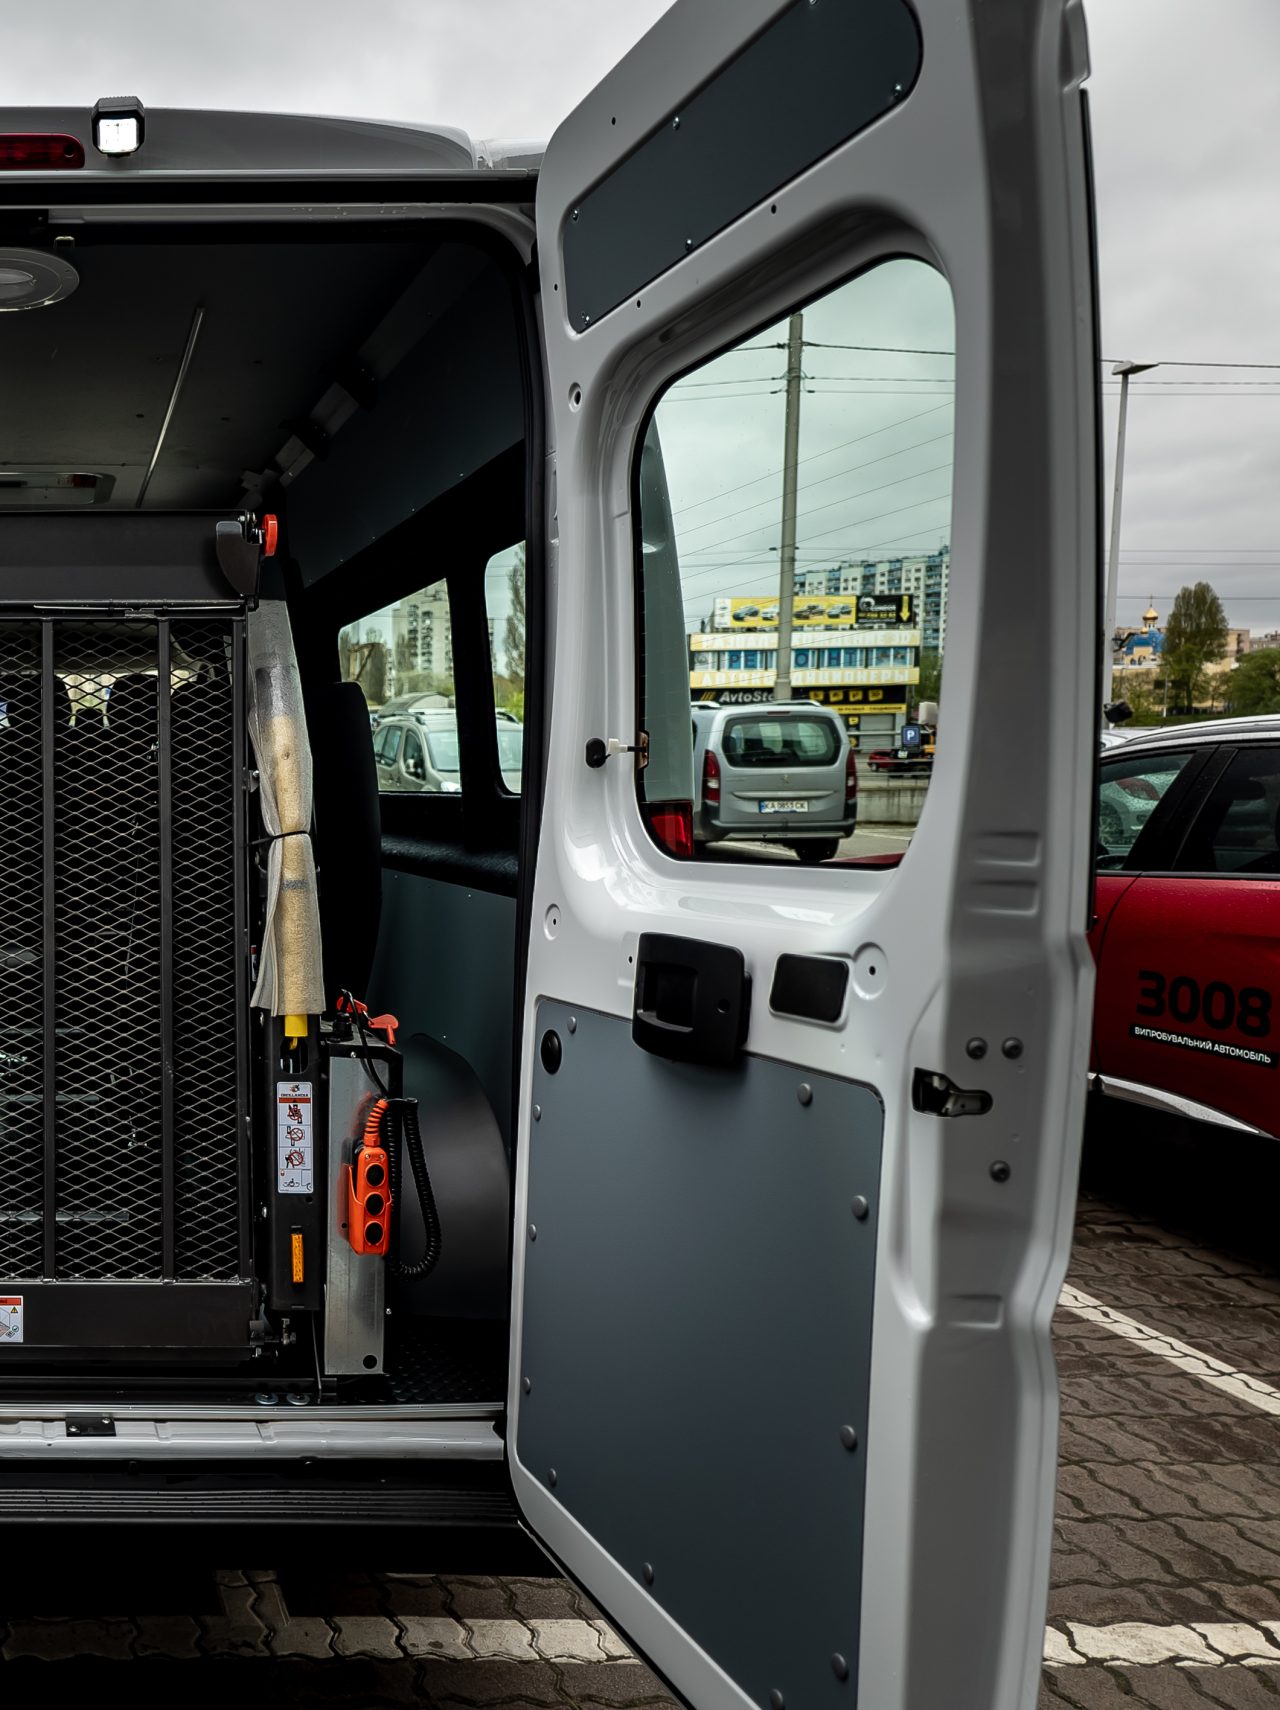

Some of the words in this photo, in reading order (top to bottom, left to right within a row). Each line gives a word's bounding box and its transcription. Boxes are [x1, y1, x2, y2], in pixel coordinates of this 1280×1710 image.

[729, 651, 857, 668] РЕОНТ
[907, 730, 915, 741] P
[1136, 970, 1272, 1038] 3008
[1134, 1026, 1213, 1051] ВИПРОБУВАЛЬНИЙ
[1213, 1043, 1272, 1064] АВТОМОБІЛЬ
